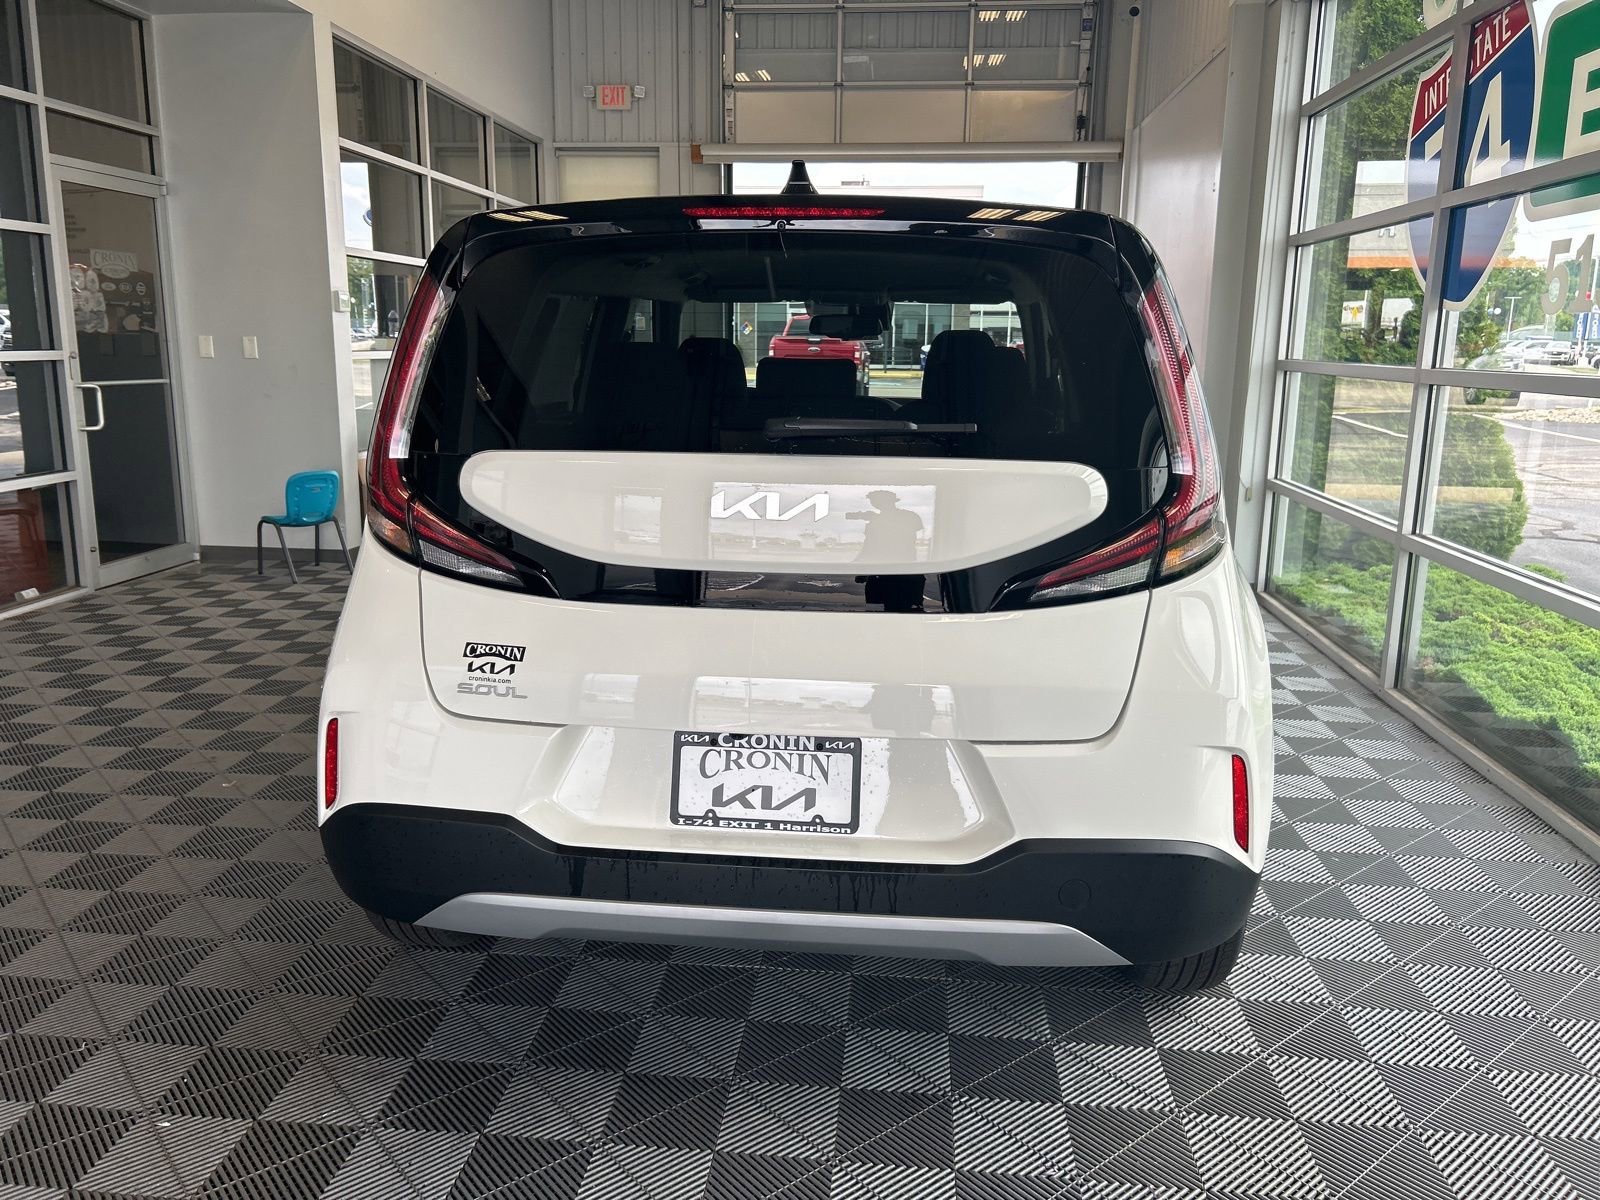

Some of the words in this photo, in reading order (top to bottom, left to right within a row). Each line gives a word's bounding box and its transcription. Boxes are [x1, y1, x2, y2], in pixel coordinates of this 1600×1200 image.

[602, 86, 626, 106] EXIT
[711, 490, 829, 522] KIA
[466, 643, 524, 661] CRONIN
[467, 661, 516, 676] KIA
[468, 676, 512, 684] croninkia.com
[457, 682, 528, 699] SOUL
[680, 734, 709, 743] KIA
[825, 741, 855, 750] KIA
[699, 748, 833, 785] CRONIN
[711, 783, 817, 812] KIA
[677, 818, 714, 827] I-74
[718, 819, 760, 829] EXIT
[764, 822, 774, 830] 1
[779, 822, 851, 834] Harrison
